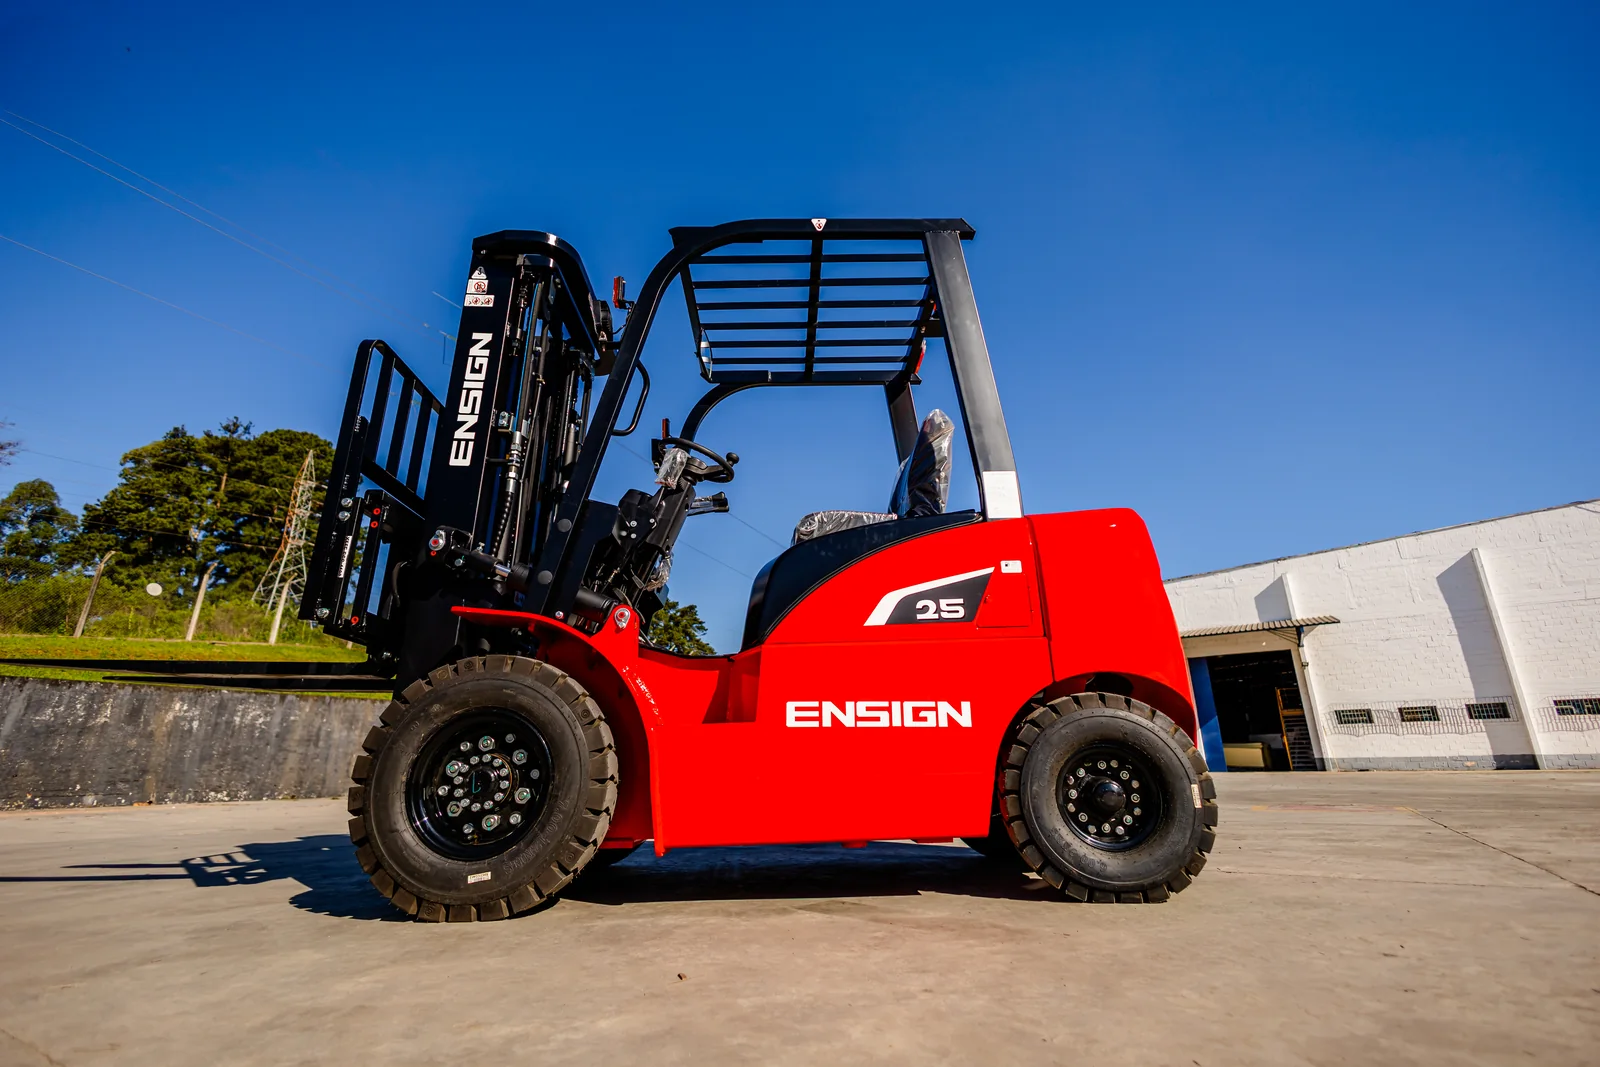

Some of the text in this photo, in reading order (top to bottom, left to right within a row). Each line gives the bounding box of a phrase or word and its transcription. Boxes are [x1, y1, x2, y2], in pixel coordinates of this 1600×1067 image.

[450, 333, 493, 467] ENSIGN
[915, 598, 965, 620] 25
[786, 701, 972, 728] ENSIGN
